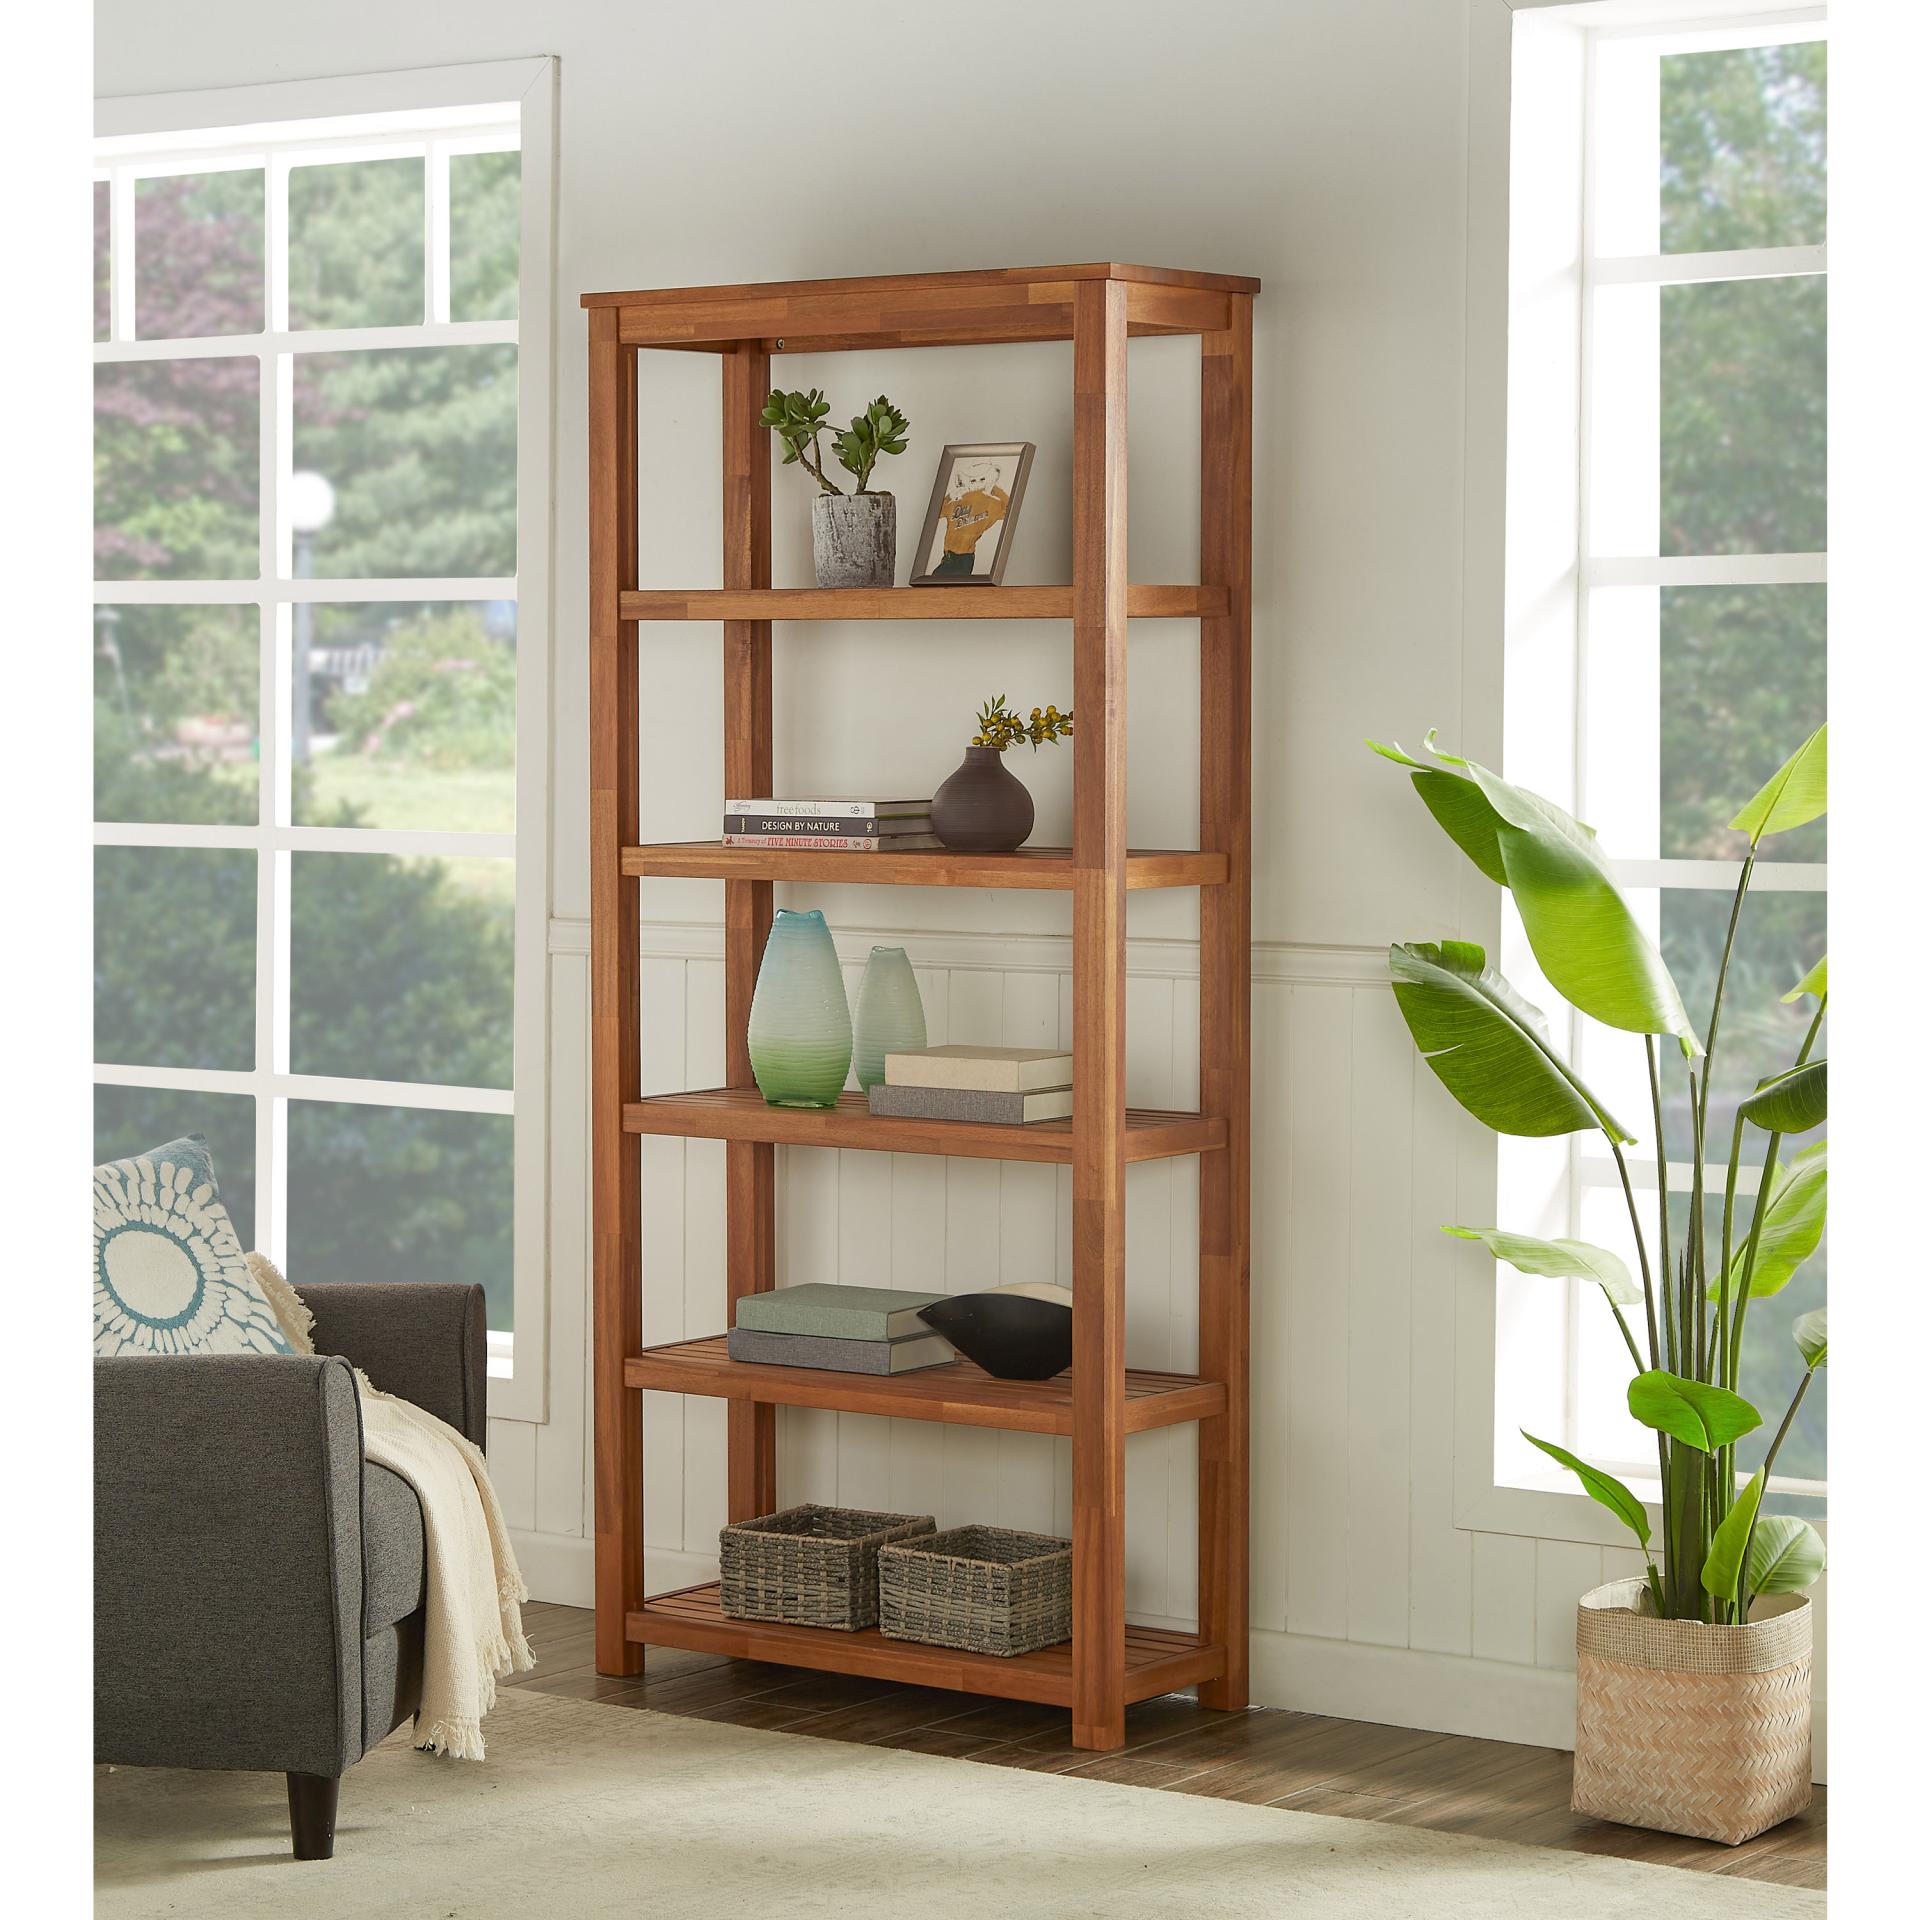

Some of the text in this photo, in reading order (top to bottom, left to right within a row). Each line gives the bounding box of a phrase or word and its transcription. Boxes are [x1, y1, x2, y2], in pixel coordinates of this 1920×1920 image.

[761, 821, 840, 832] DESIGN BY NATURE
[767, 837, 785, 847] FIVE
[786, 838, 812, 848] MINUTE
[813, 838, 849, 848] STORIES
